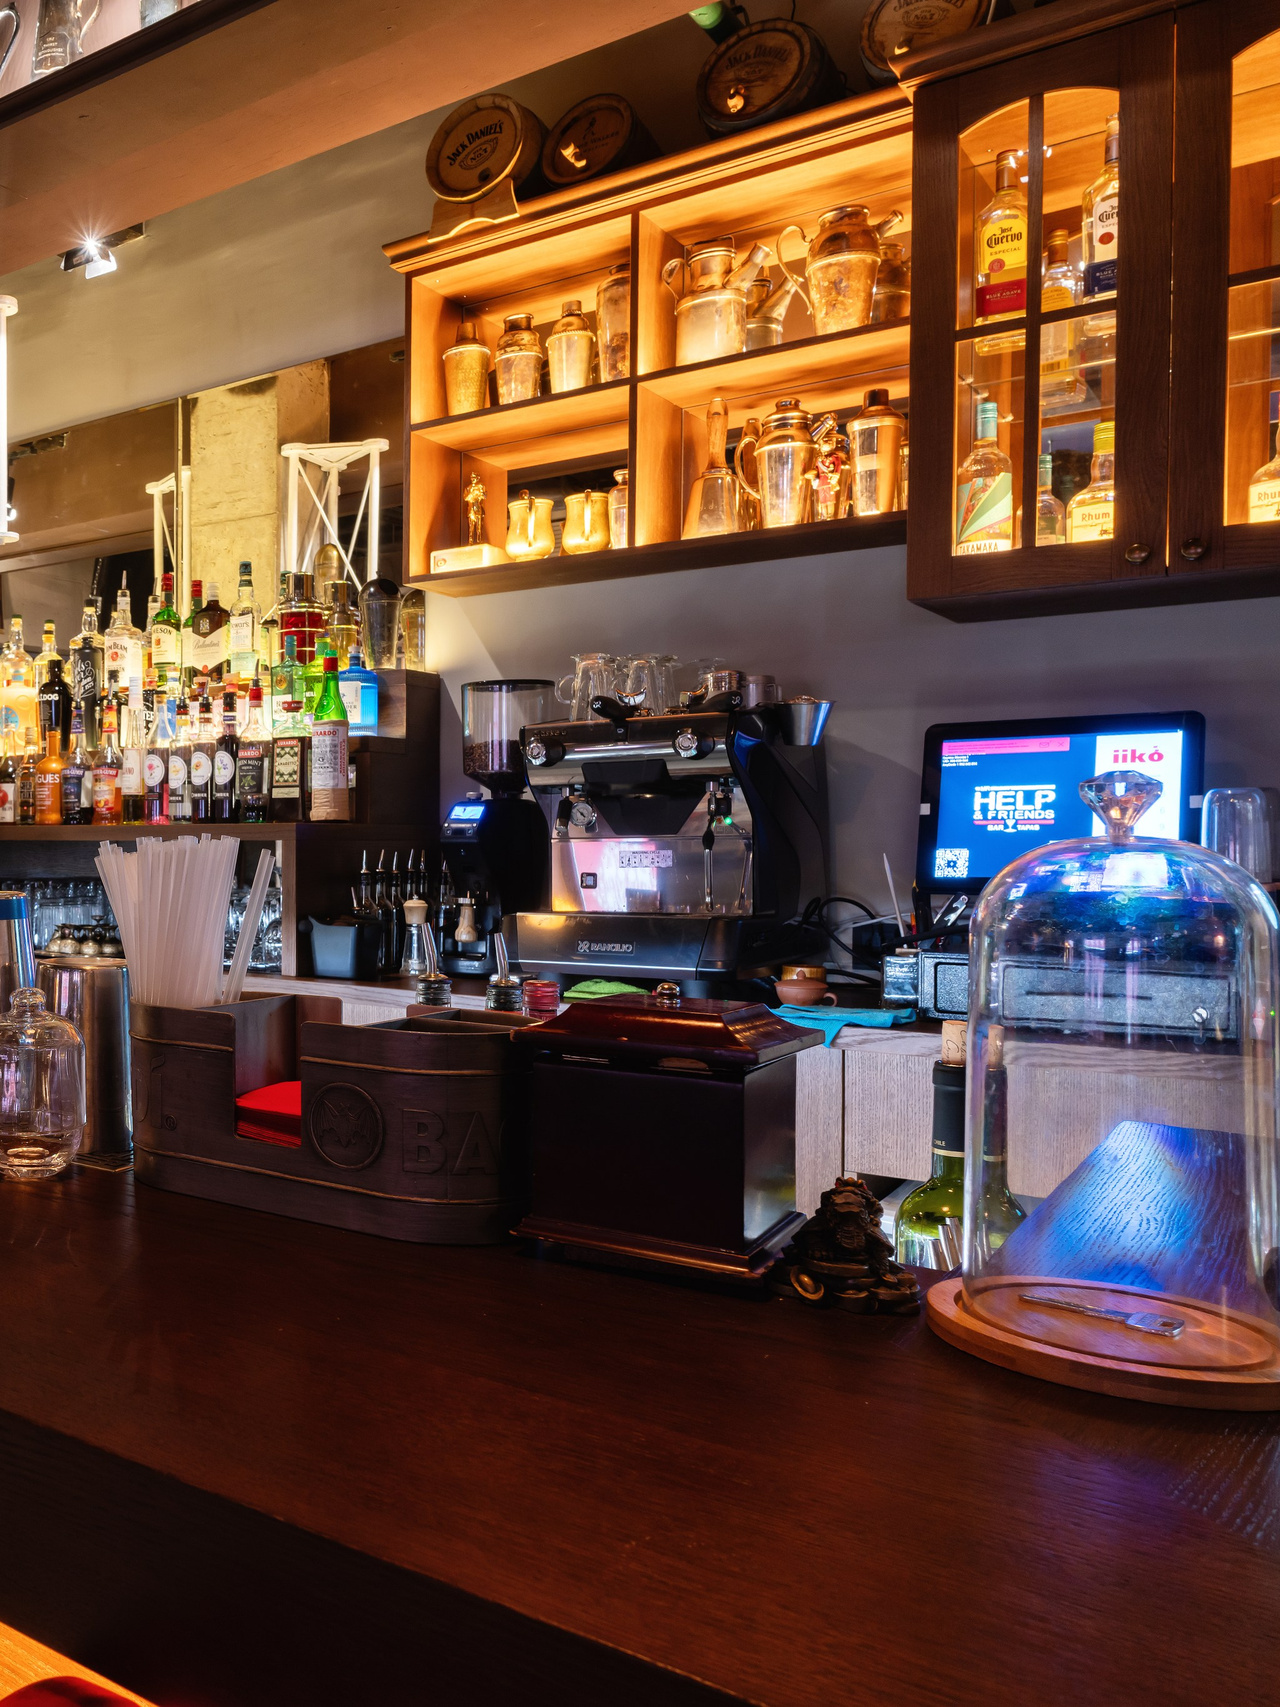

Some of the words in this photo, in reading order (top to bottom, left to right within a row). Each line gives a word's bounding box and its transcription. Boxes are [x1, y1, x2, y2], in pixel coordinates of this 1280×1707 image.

[447, 141, 469, 166] JACK
[466, 120, 504, 145] DANIEL'S
[999, 226, 1013, 236] Jose
[986, 231, 1023, 249] Cuervo
[989, 247, 1021, 256] ESPECIAL
[1257, 489, 1280, 502] Rhu
[1080, 511, 1110, 522] Rhum
[974, 790, 1056, 811] HELP
[973, 810, 983, 819] &
[987, 810, 1055, 820] FRIENDS
[590, 942, 634, 953] RANCILIO
